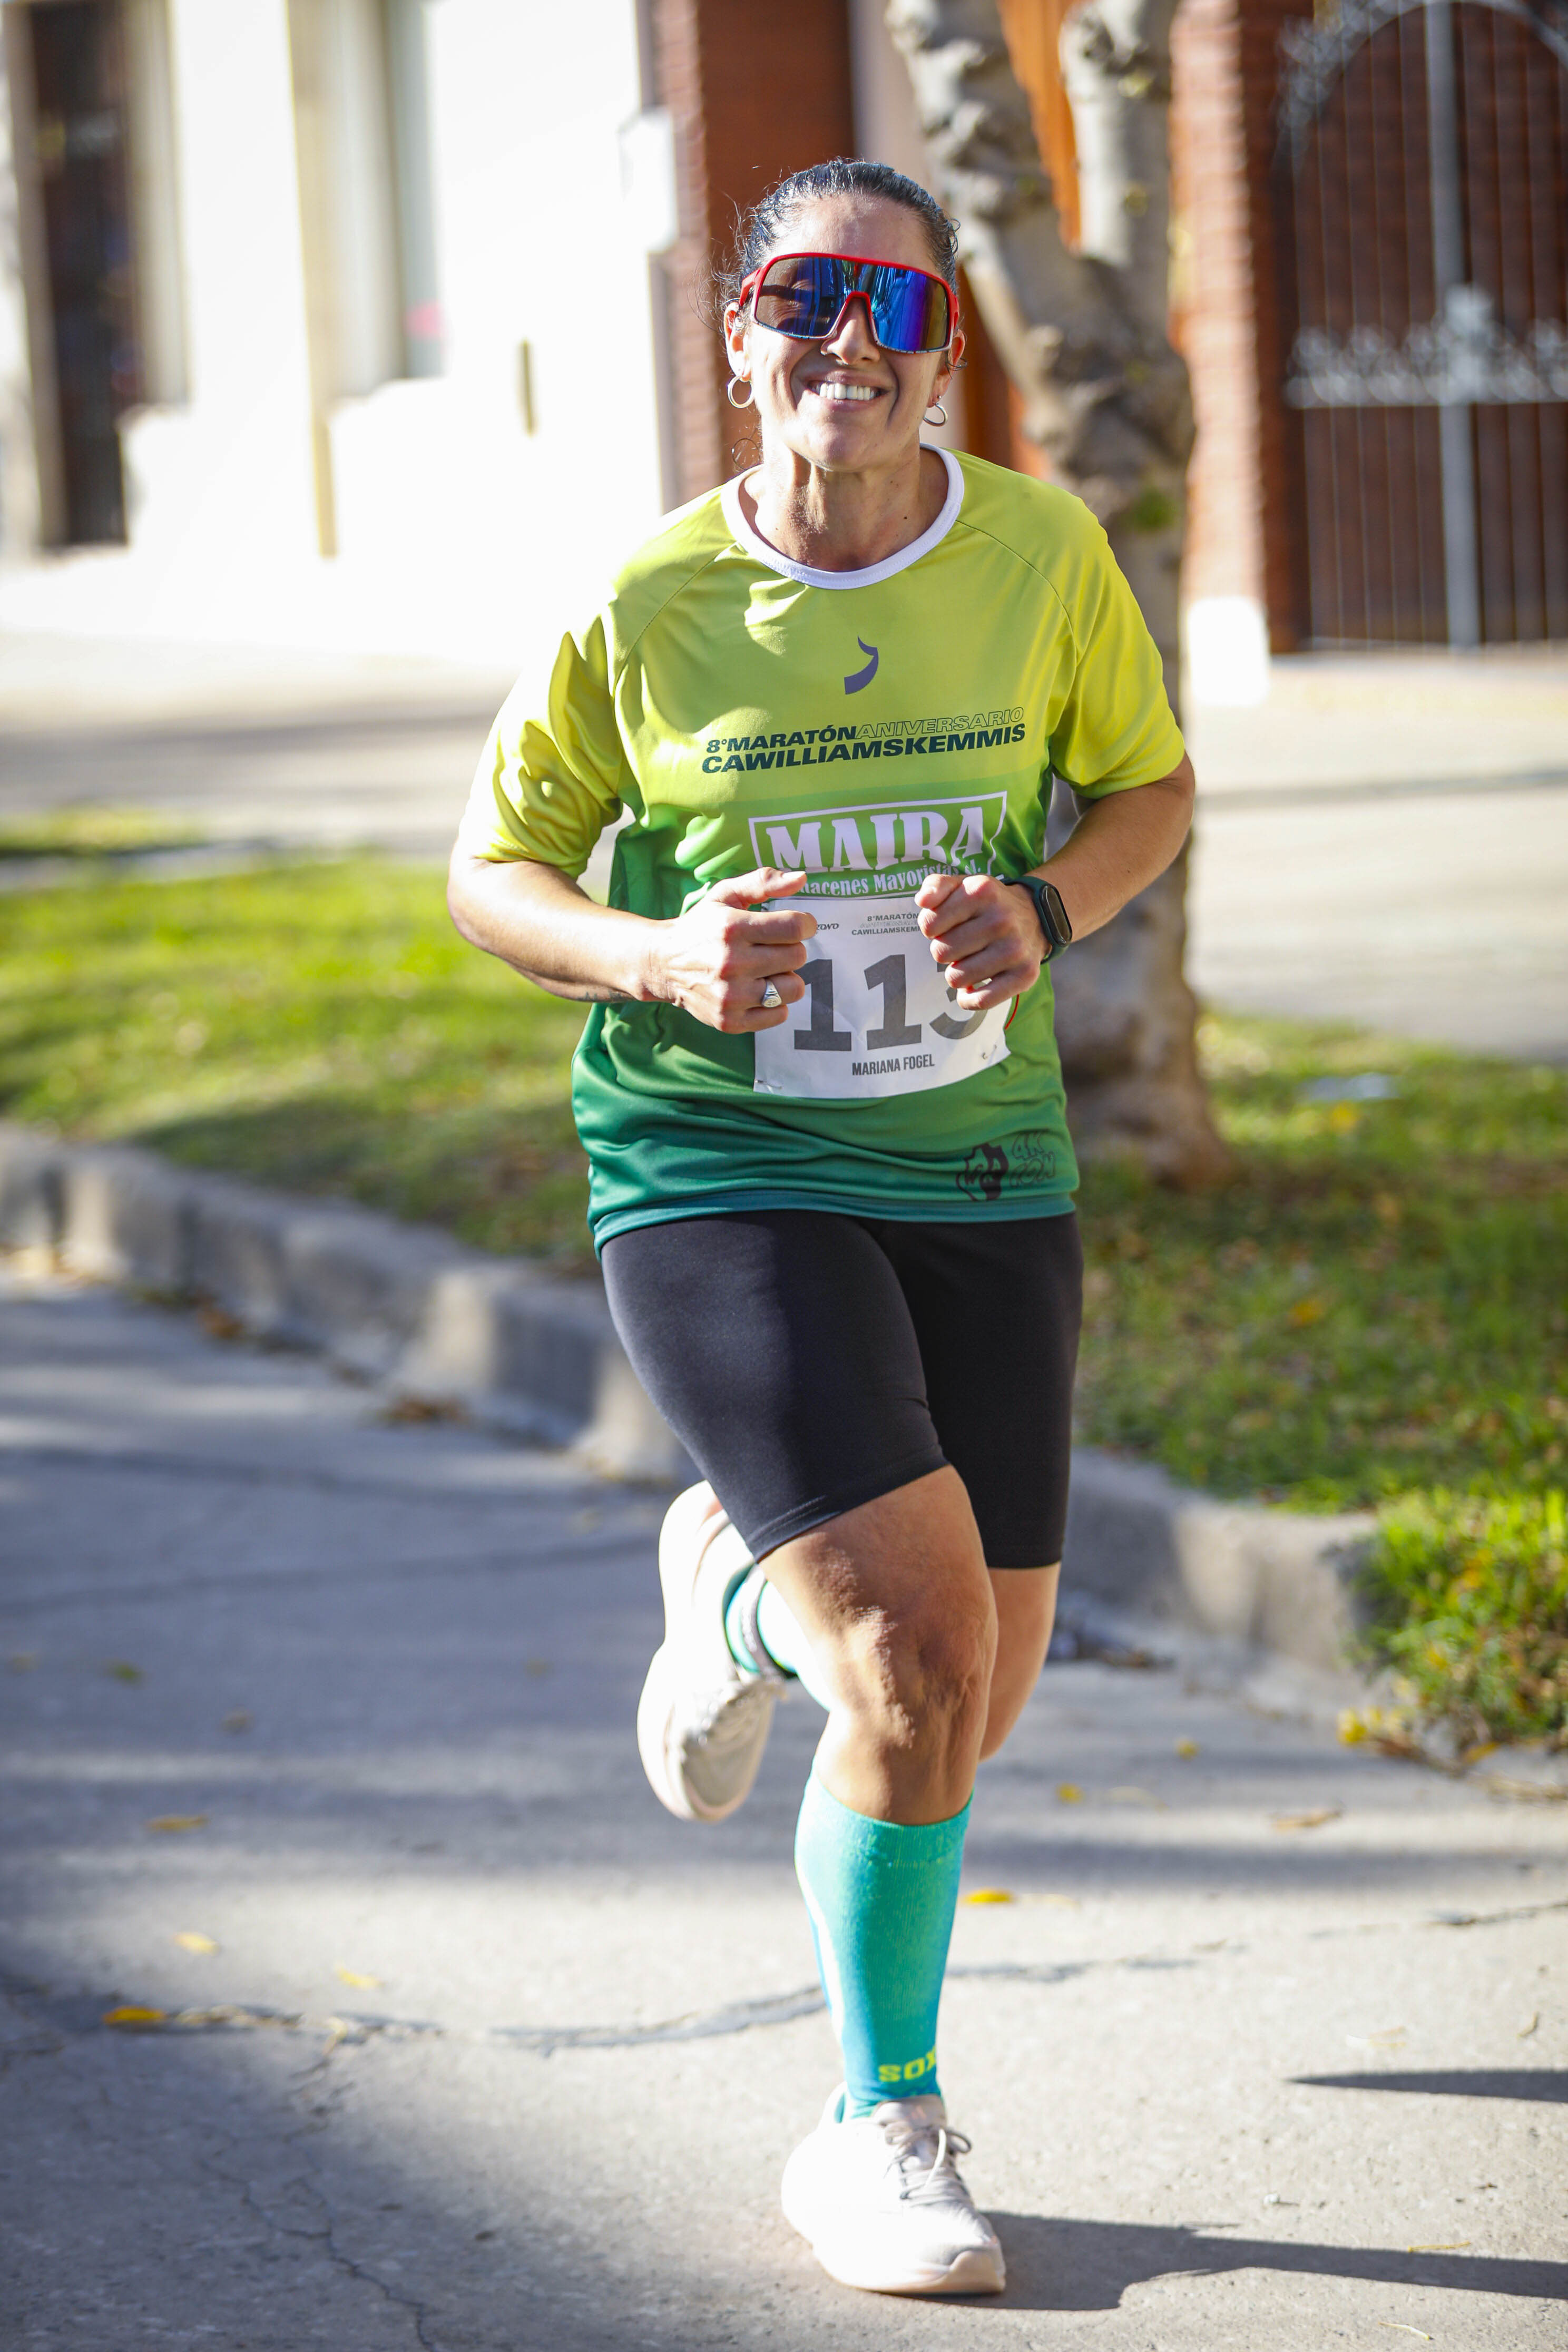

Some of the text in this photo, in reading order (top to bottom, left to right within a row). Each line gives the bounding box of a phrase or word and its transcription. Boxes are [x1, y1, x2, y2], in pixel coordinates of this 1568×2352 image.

[855, 707, 1024, 740] ANIVERSARIO
[702, 723, 1026, 774] CAWILLIAMSKEMMIS
[766, 806, 984, 874] MAIRA
[851, 1053, 935, 1076] MARIANA FOGEL
